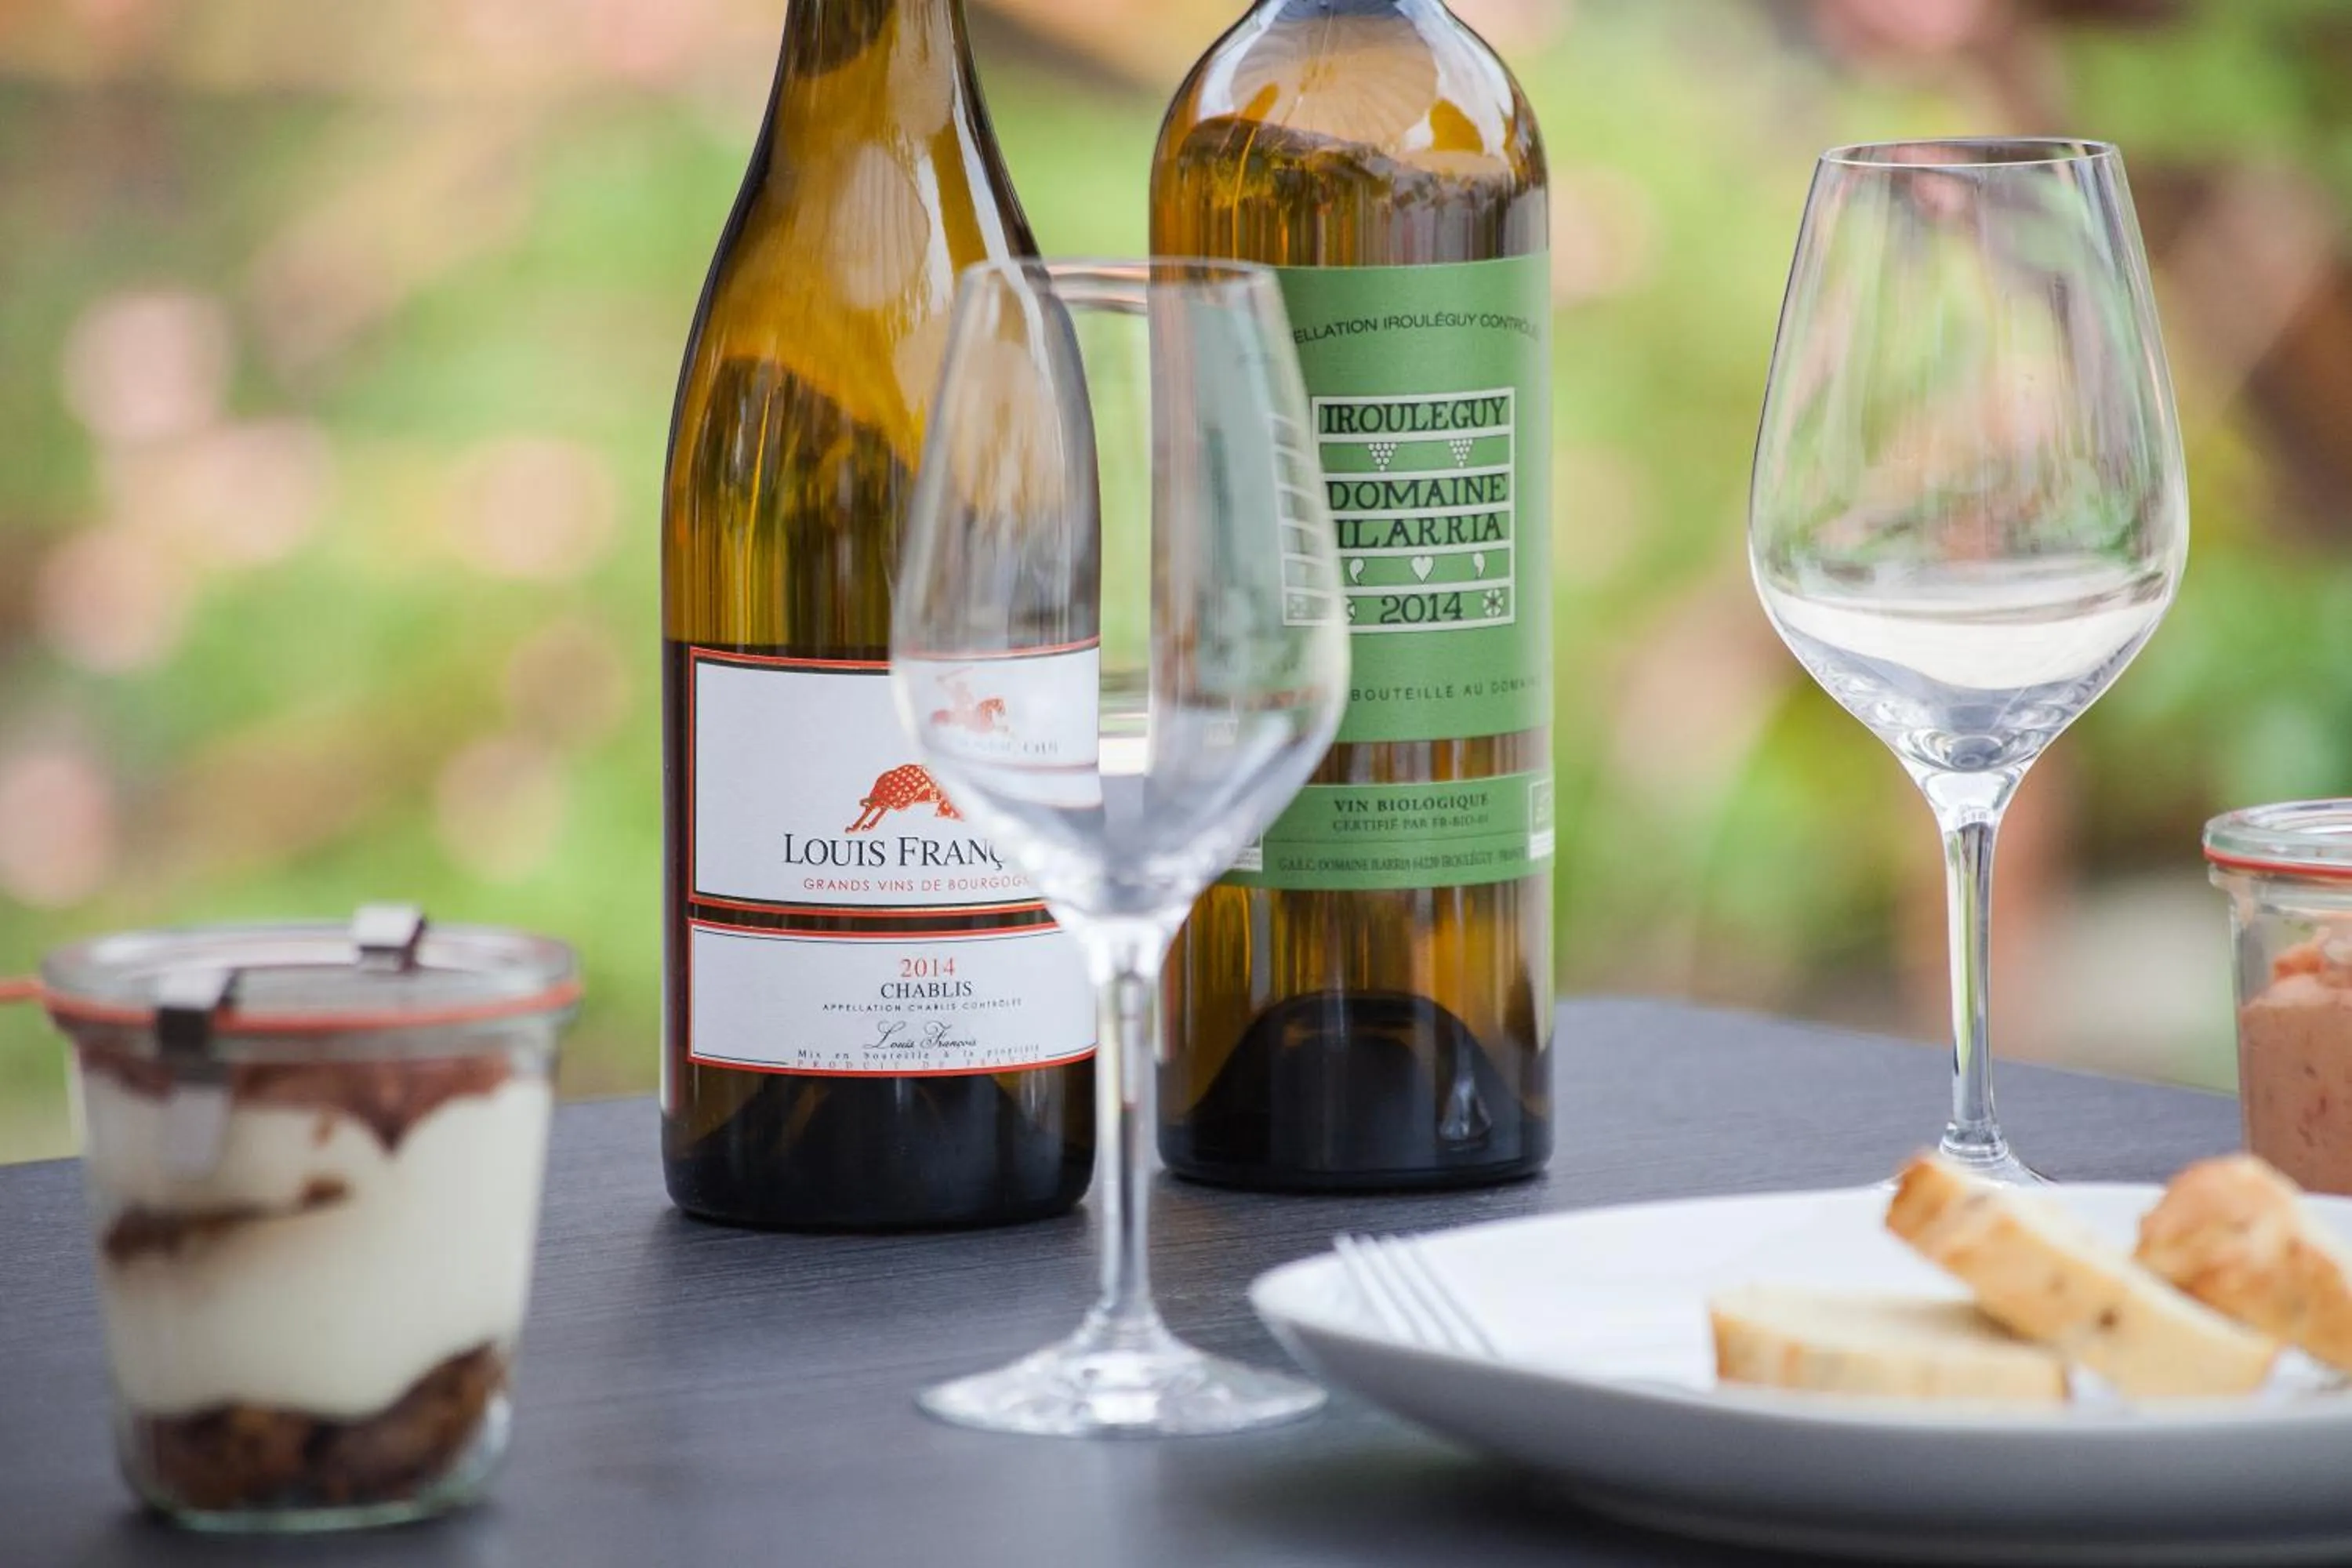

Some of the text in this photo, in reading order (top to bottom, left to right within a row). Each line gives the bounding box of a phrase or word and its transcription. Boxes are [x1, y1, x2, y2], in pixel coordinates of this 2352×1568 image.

[1293, 318, 1377, 344] ELLATION
[1384, 311, 1477, 331] IROULÉGUY
[1323, 397, 1507, 434] IROULEGUY
[1326, 473, 1507, 510] DOMAINE
[1337, 512, 1504, 549] ILARRIA
[1379, 593, 1464, 625] 2014
[1351, 684, 1454, 702] BOUTEILLE
[1463, 681, 1483, 698] AU
[1334, 793, 1489, 813] VIN BIOLOGIQUE
[784, 833, 1004, 871] LOUIS FRANÇ
[803, 877, 870, 892] GRANDS
[878, 878, 914, 892] VINS
[922, 878, 942, 891] DE
[900, 956, 956, 978] 2014
[880, 980, 974, 1000] CHABLIS
[822, 1004, 901, 1013] APPELLATION
[908, 1003, 956, 1012] CHABLIS
[864, 1019, 915, 1050] Louis
